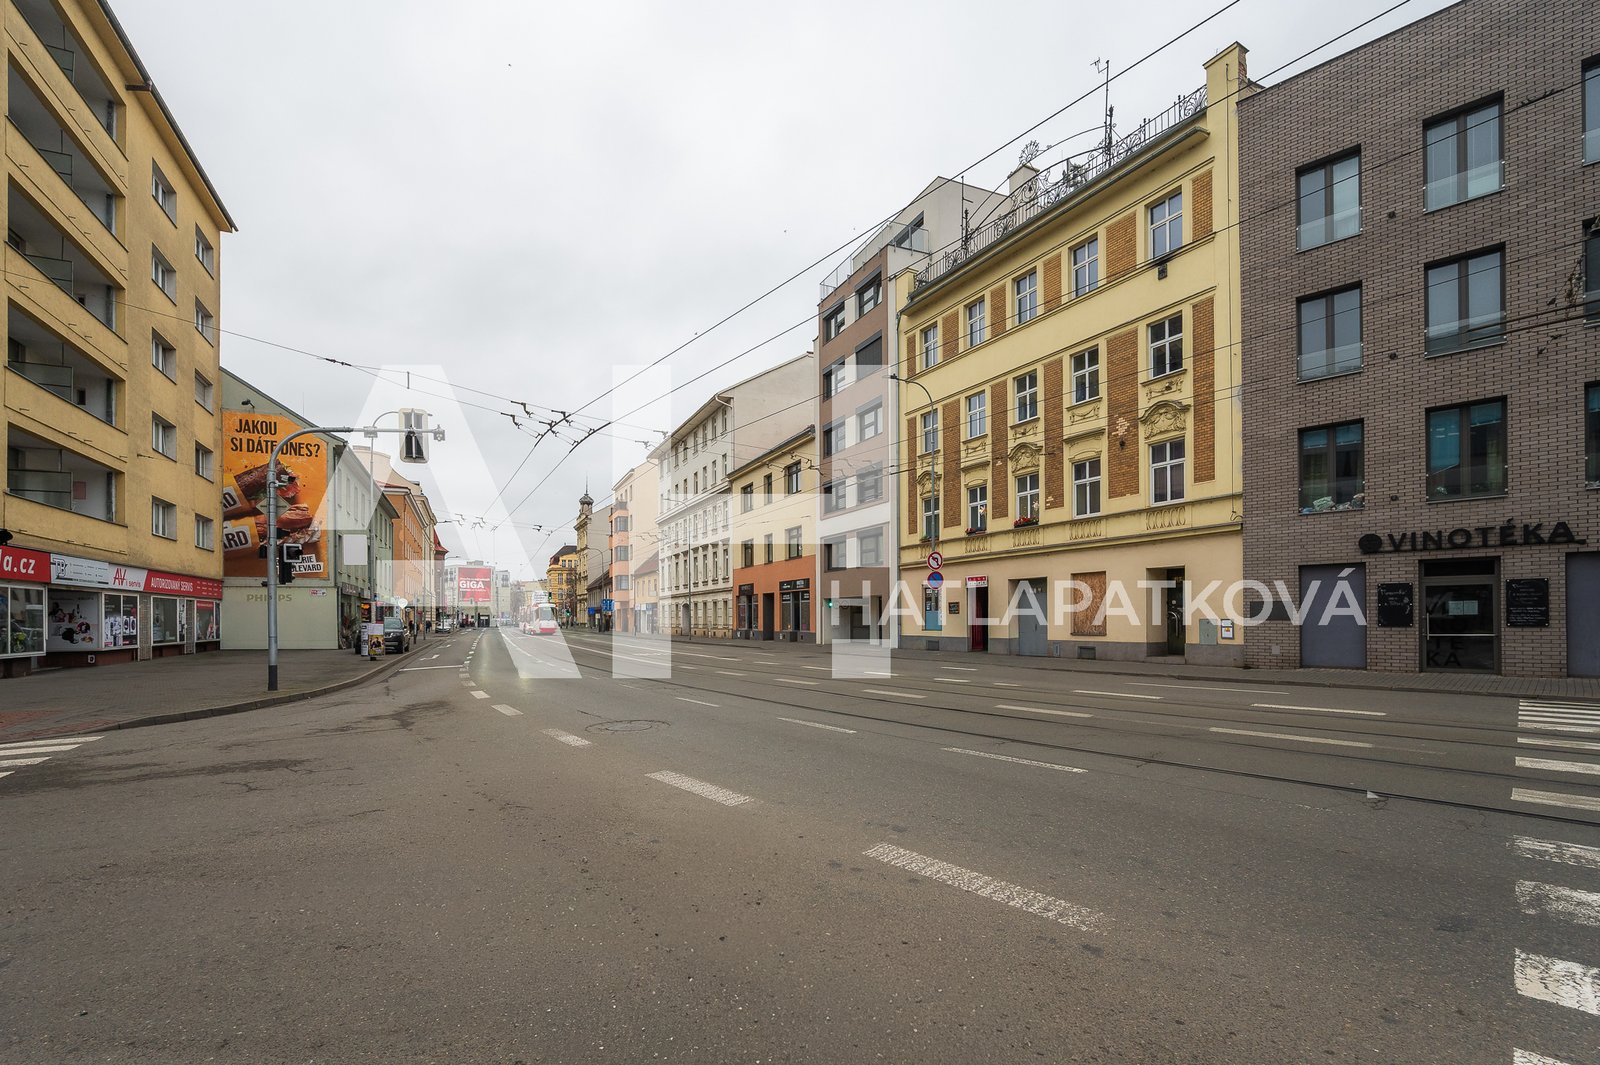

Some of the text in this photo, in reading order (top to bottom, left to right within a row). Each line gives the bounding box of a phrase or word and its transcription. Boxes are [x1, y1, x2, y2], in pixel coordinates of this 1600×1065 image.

[235, 418, 277, 436] JAKOU
[230, 435, 321, 458] SI DÁTE DNES?
[1387, 518, 1576, 551] VINOTÉKA
[0, 549, 36, 575] a.cz
[180, 581, 194, 592] SERVIS
[459, 580, 485, 589] GIGA
[246, 593, 293, 602] PHIPS
